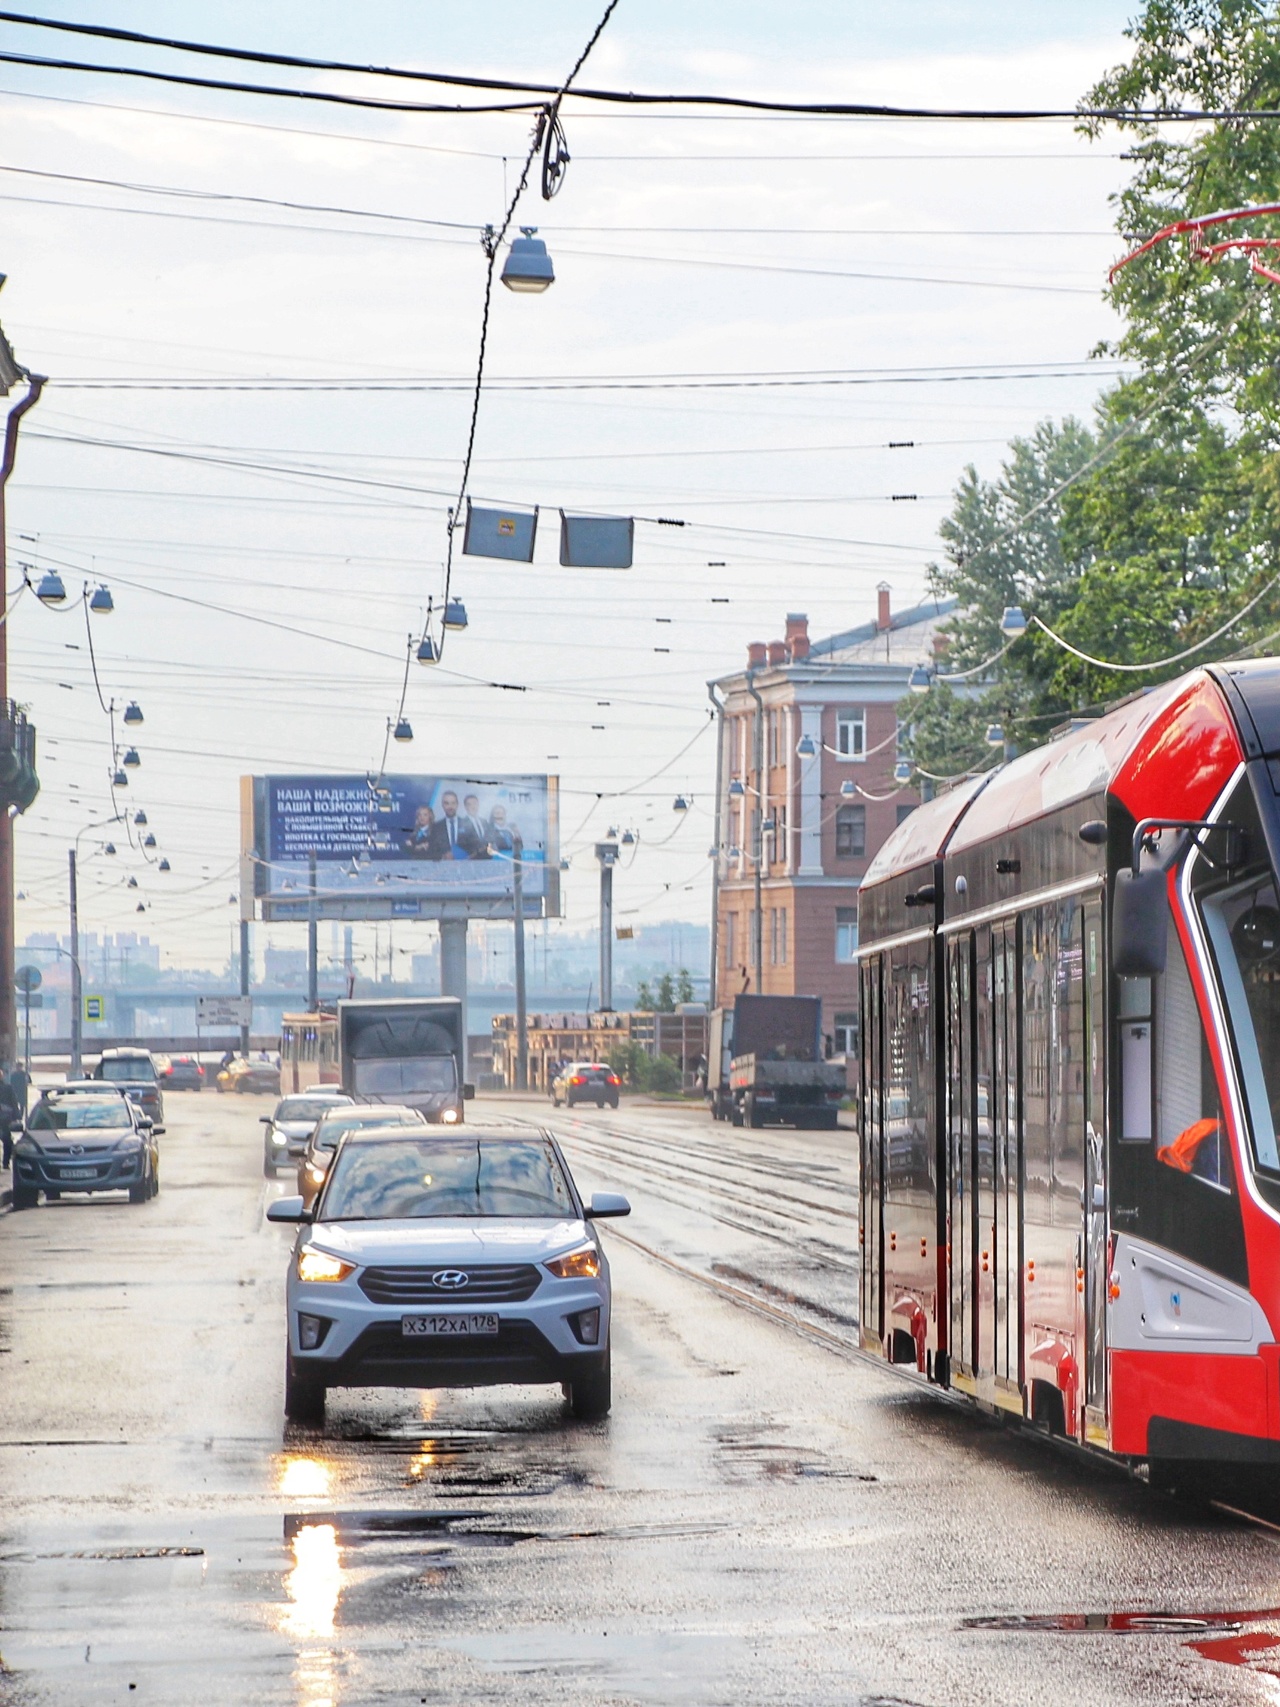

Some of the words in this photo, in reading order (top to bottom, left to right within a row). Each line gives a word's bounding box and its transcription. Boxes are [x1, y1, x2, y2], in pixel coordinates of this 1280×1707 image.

[277, 789, 312, 800] НАША
[278, 801, 311, 812] ВАШИ
[313, 801, 400, 812] ВОЗМОЖНОИ
[284, 833, 319, 841] ИПОТЕКА
[284, 843, 331, 851] БЕСПЛАТНАЯ
[408, 1317, 468, 1333] Х312ХА
[472, 1315, 495, 1327] 178
